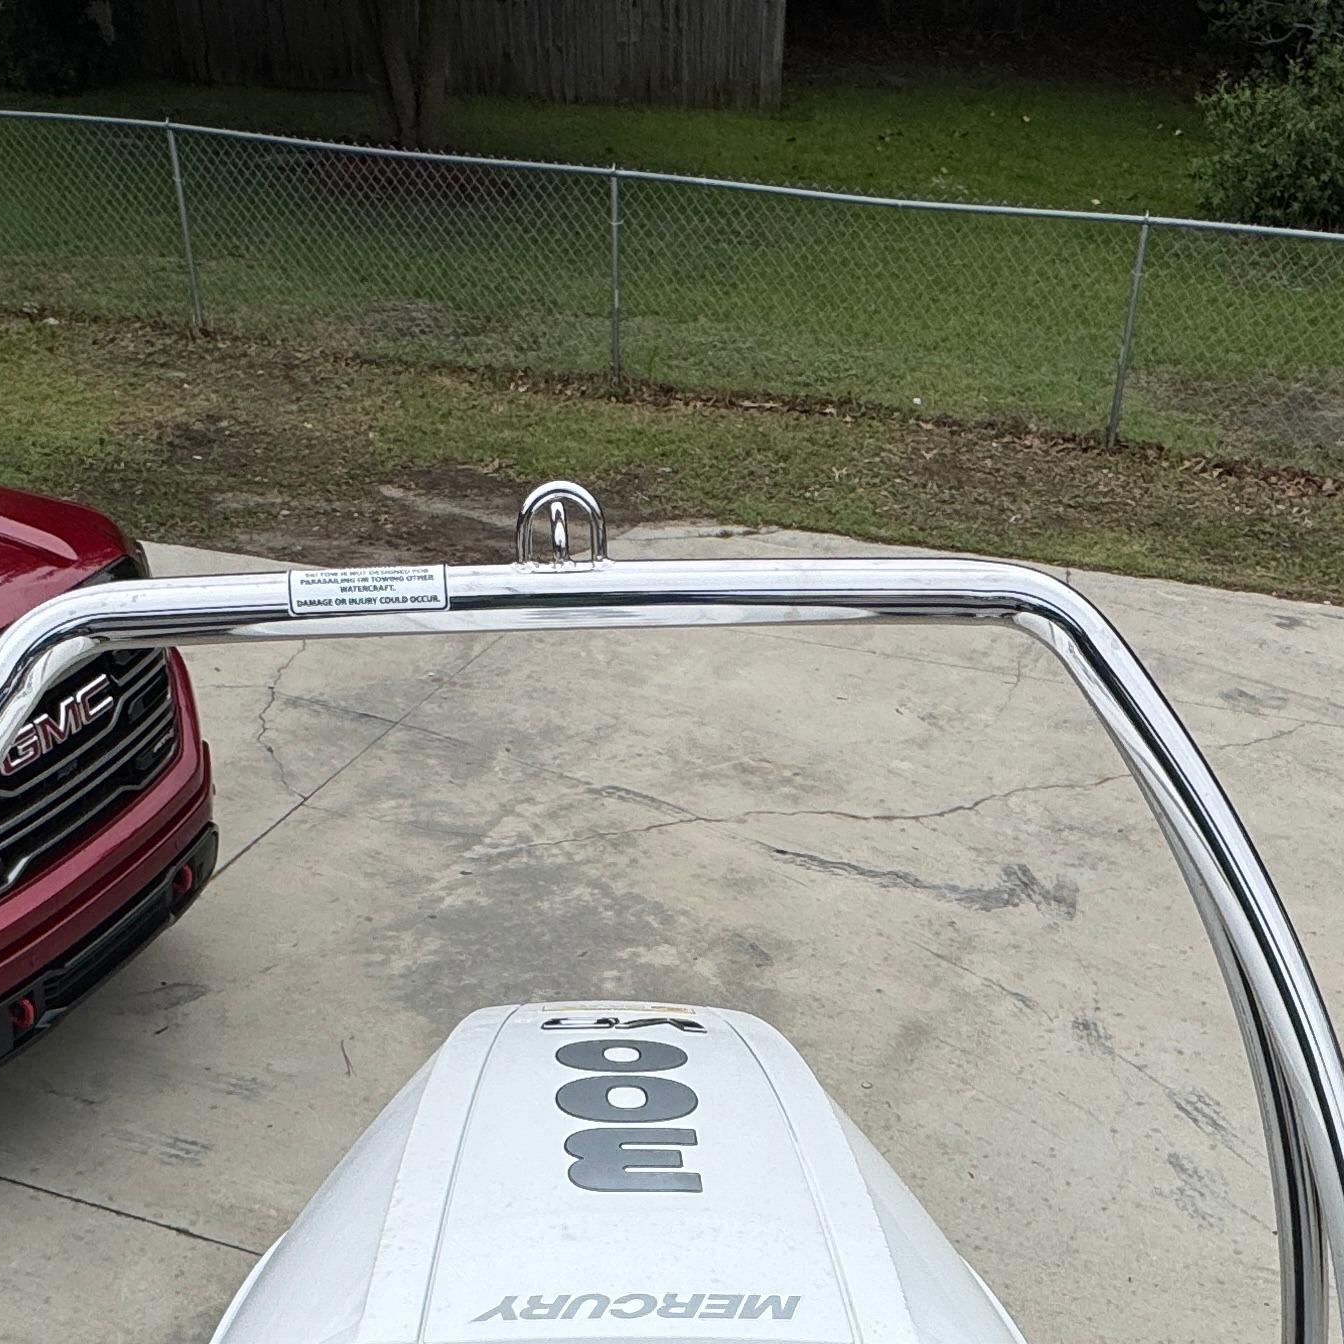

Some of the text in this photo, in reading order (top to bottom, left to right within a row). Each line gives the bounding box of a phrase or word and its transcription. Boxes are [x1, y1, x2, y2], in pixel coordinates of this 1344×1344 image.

[300, 577, 356, 585] PARASAILING
[340, 584, 396, 593] WATERCRAFT.
[296, 594, 441, 608] DAMAGE OR INJURY COULD OCCUR.
[1, 673, 114, 776] GMC
[555, 1039, 704, 1193] 300
[470, 1293, 802, 1321] MERCURY
